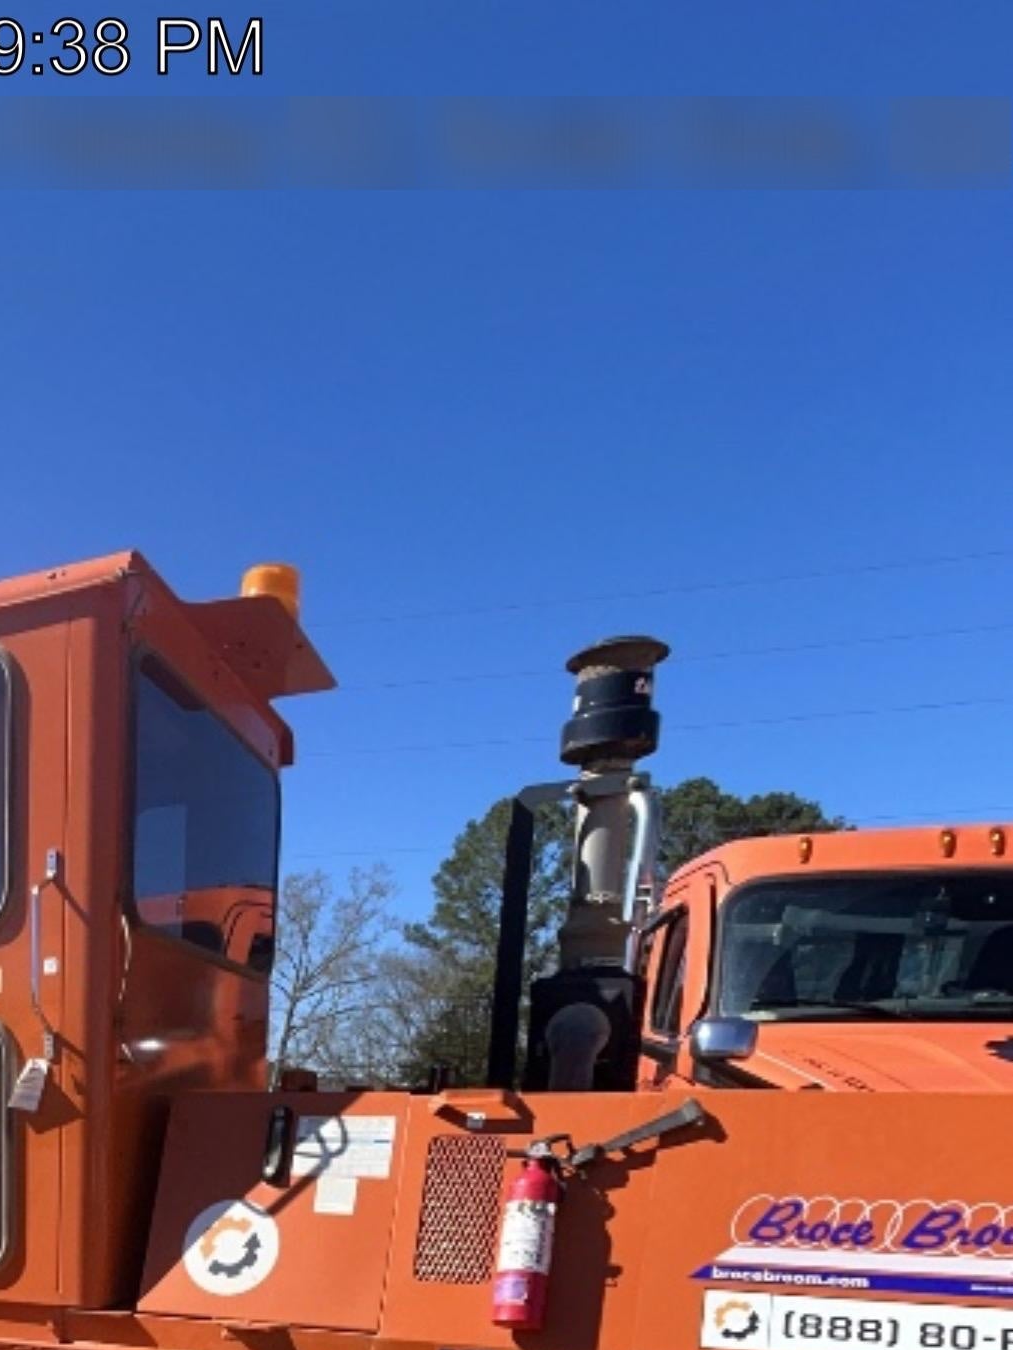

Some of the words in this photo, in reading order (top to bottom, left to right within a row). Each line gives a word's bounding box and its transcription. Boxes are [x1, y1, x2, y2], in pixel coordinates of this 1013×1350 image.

[748, 1200, 875, 1246] Broce
[711, 1267, 871, 1288] brocebroom.com
[783, 1310, 900, 1347] (888)
